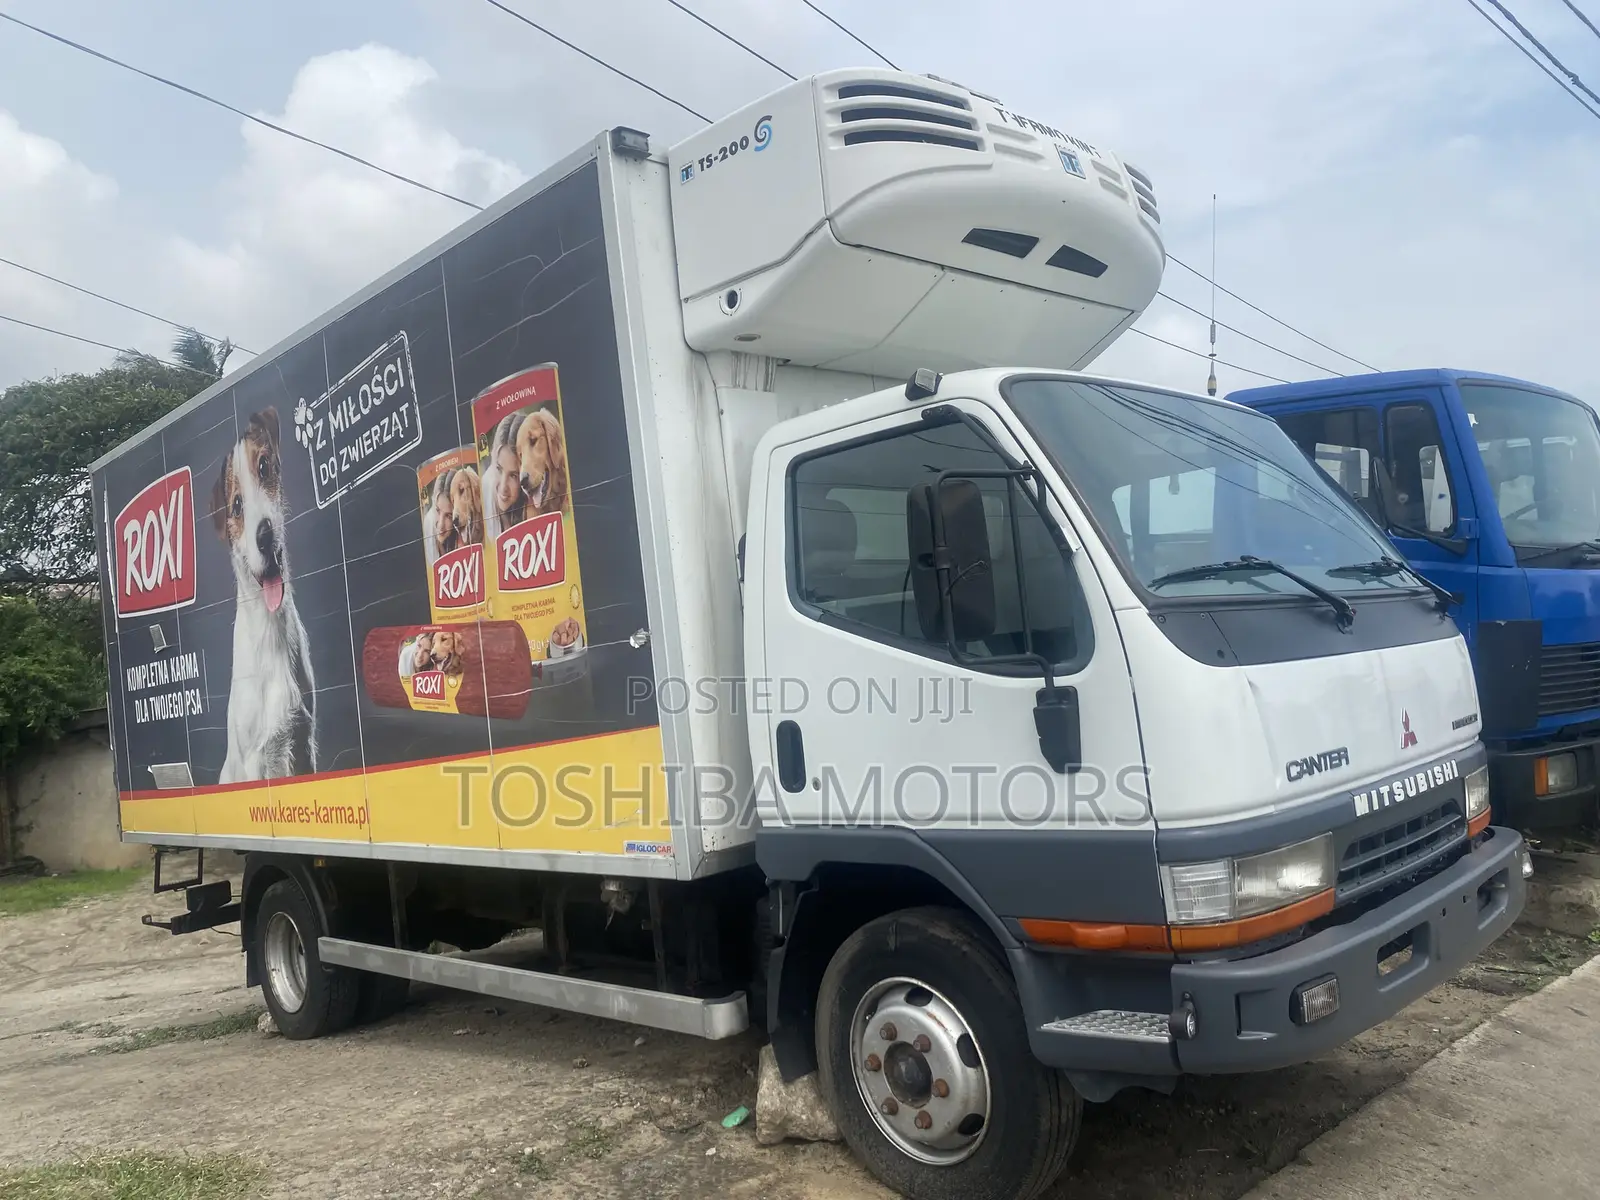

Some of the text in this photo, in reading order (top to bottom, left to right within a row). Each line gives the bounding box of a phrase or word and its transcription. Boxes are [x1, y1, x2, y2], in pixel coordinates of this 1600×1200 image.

[698, 135, 750, 172] TS-200
[313, 357, 404, 451] Z MIŁOŚCI
[496, 386, 537, 410] Z WOŁOWINĄ
[319, 402, 409, 486] DO ZWIERZĄT
[123, 484, 185, 597] ROXI
[503, 520, 558, 582] ROXI
[437, 551, 480, 600] ROXI
[126, 652, 200, 692] KOMPLETNA KARMA
[415, 674, 442, 695] ROXI
[134, 688, 203, 724] DLA TWOJEGO PSA
[1285, 746, 1350, 783] CANTER
[1353, 759, 1460, 818] MITSUBISHI
[249, 799, 370, 830] www.kares-karma.pl
[636, 844, 672, 853] IGLOOCAR
